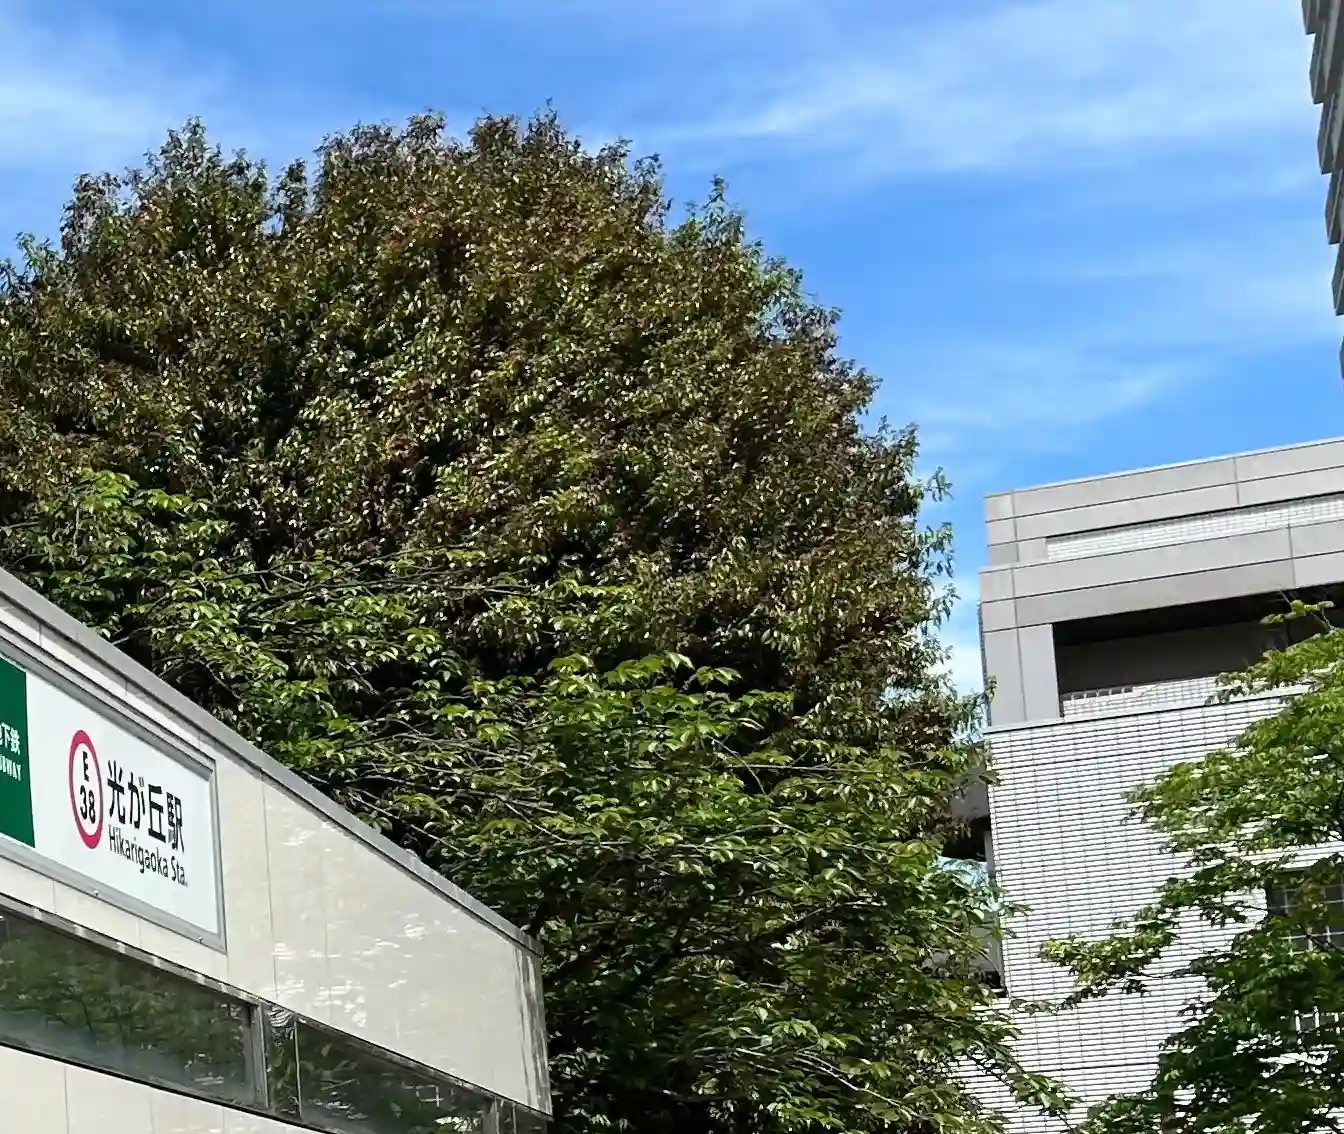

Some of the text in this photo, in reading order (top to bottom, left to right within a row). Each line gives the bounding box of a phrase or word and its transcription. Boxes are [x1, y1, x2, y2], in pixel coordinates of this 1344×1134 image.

[82, 750, 90, 783] E
[79, 784, 96, 824] 38
[107, 759, 185, 853] 光が丘駅
[108, 824, 188, 888] Hikarigaoka Sta.
